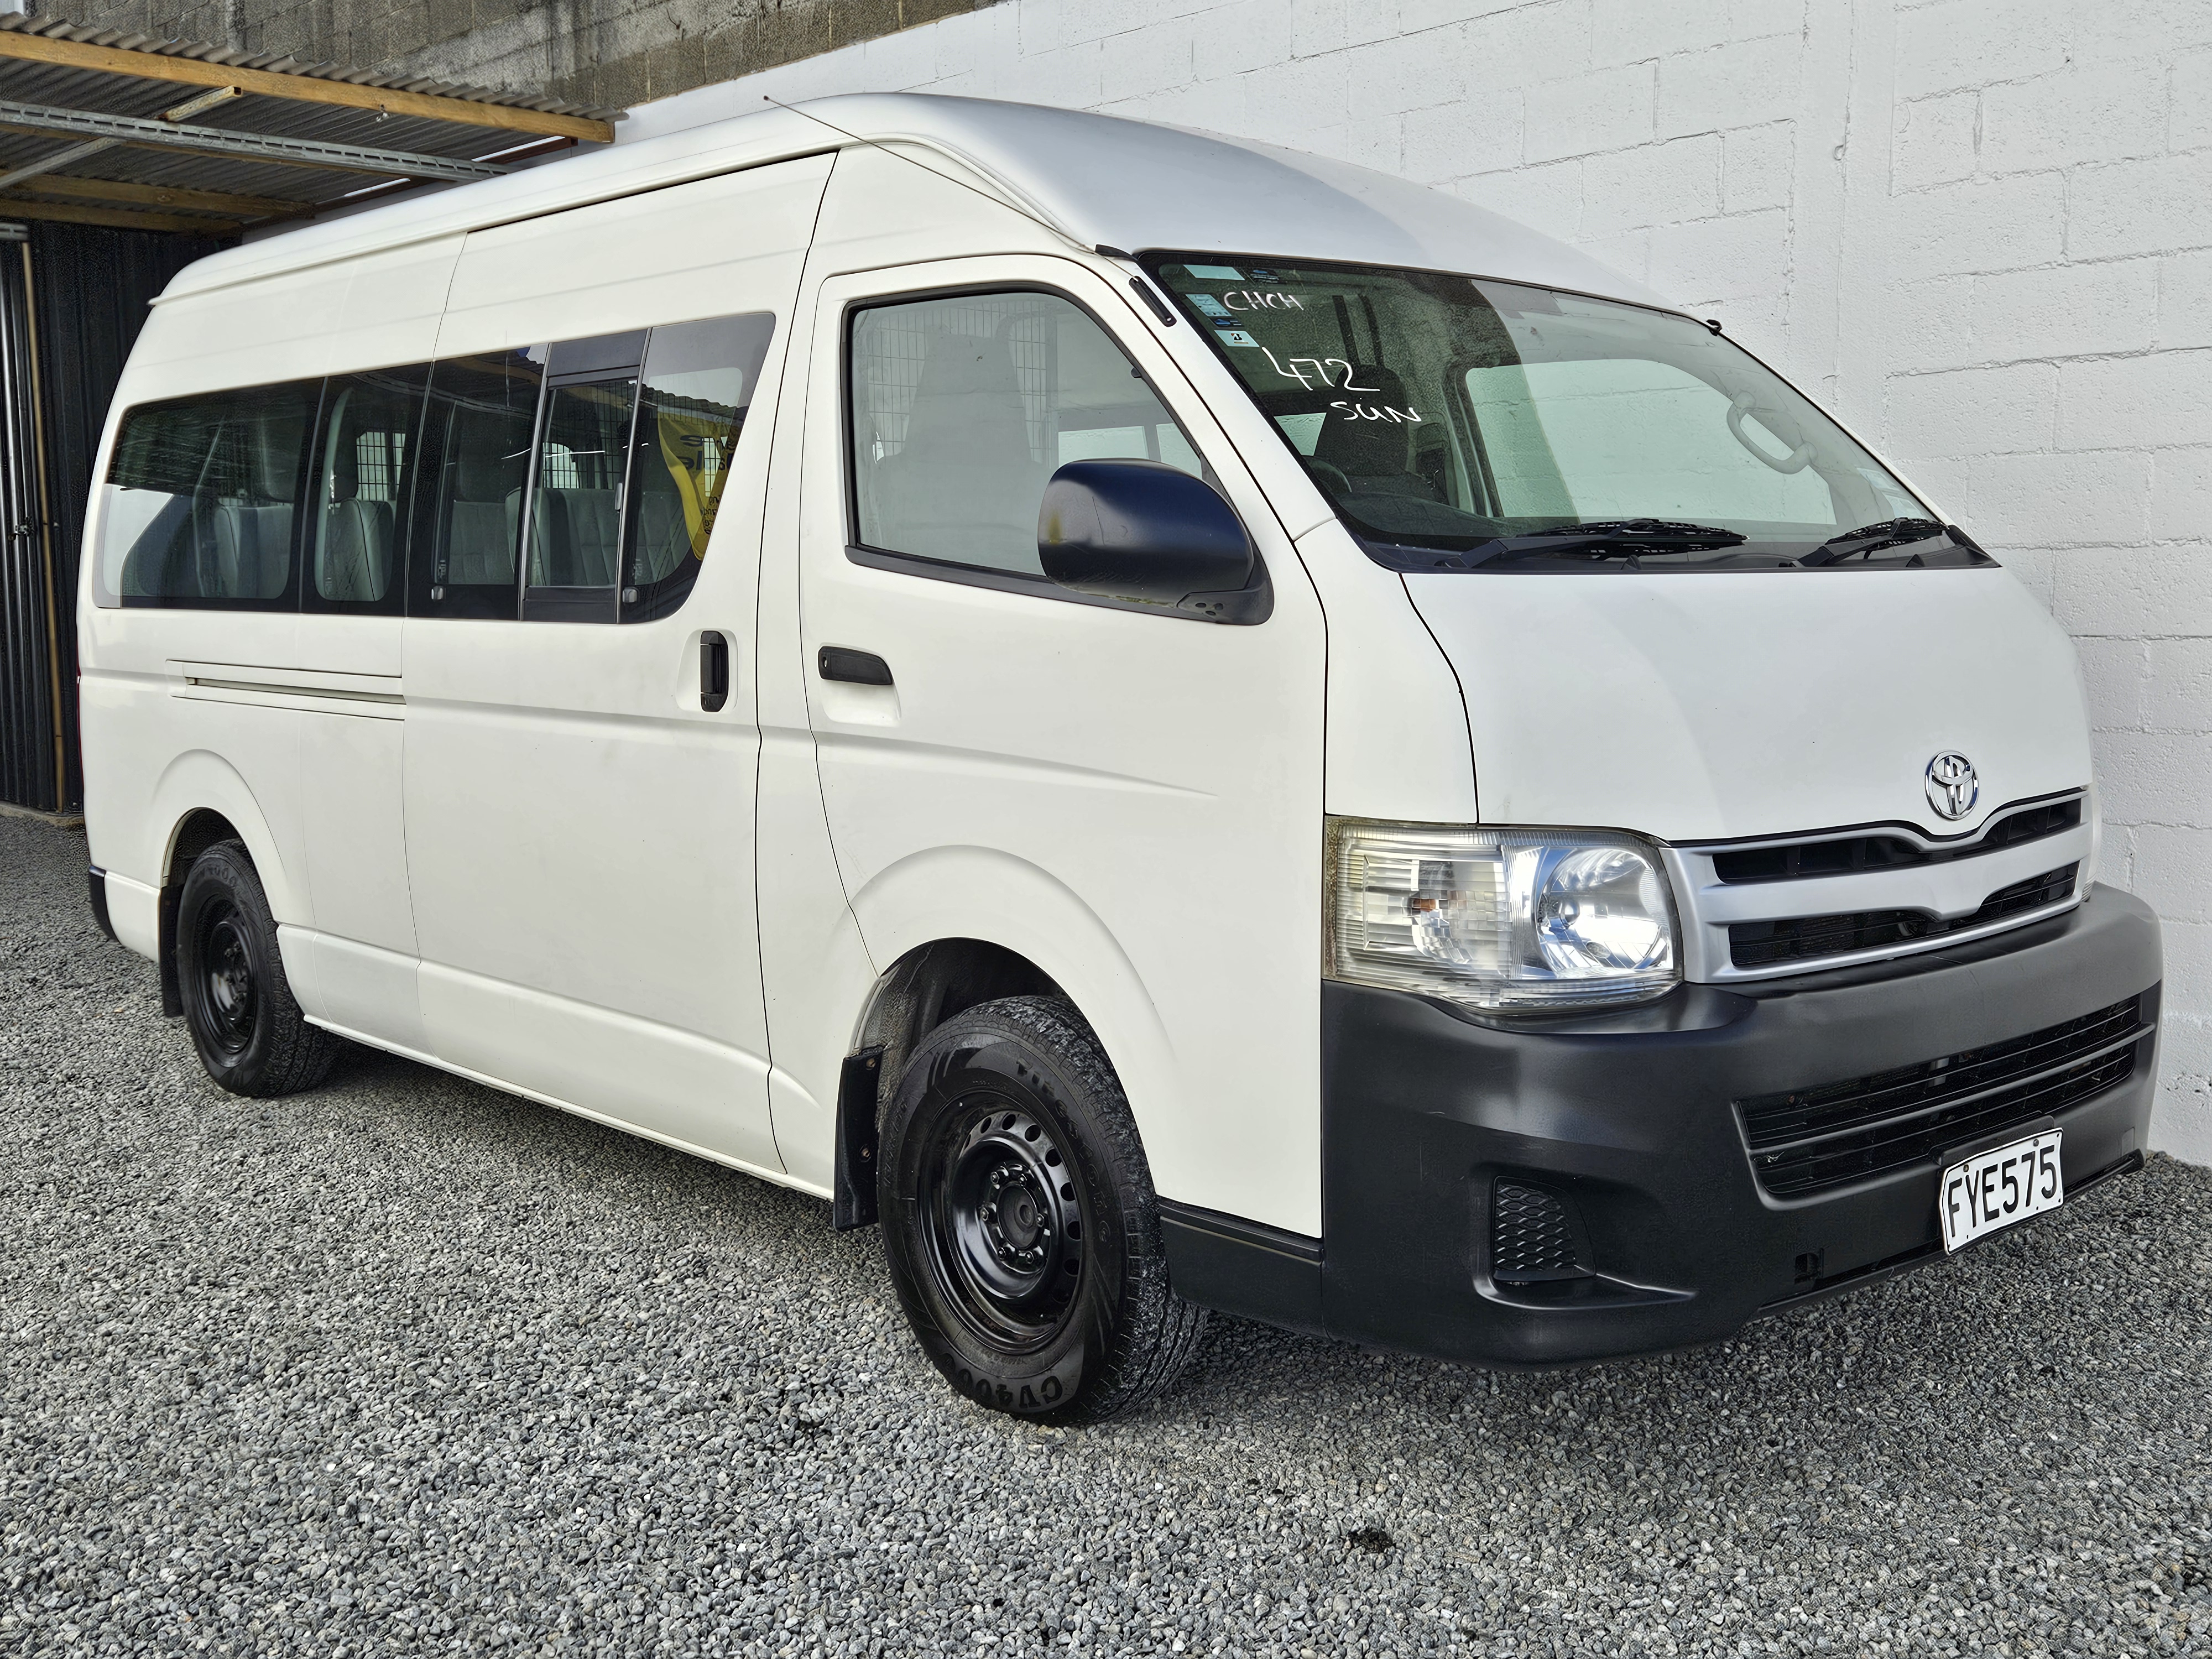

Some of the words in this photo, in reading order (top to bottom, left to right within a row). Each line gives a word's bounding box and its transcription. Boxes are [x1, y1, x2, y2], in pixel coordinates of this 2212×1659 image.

[1223, 290, 1304, 311] CHCH
[1261, 347, 1380, 392] 472
[1948, 1144, 2058, 1238] FYE575
[942, 1352, 1063, 1409] CV4000
